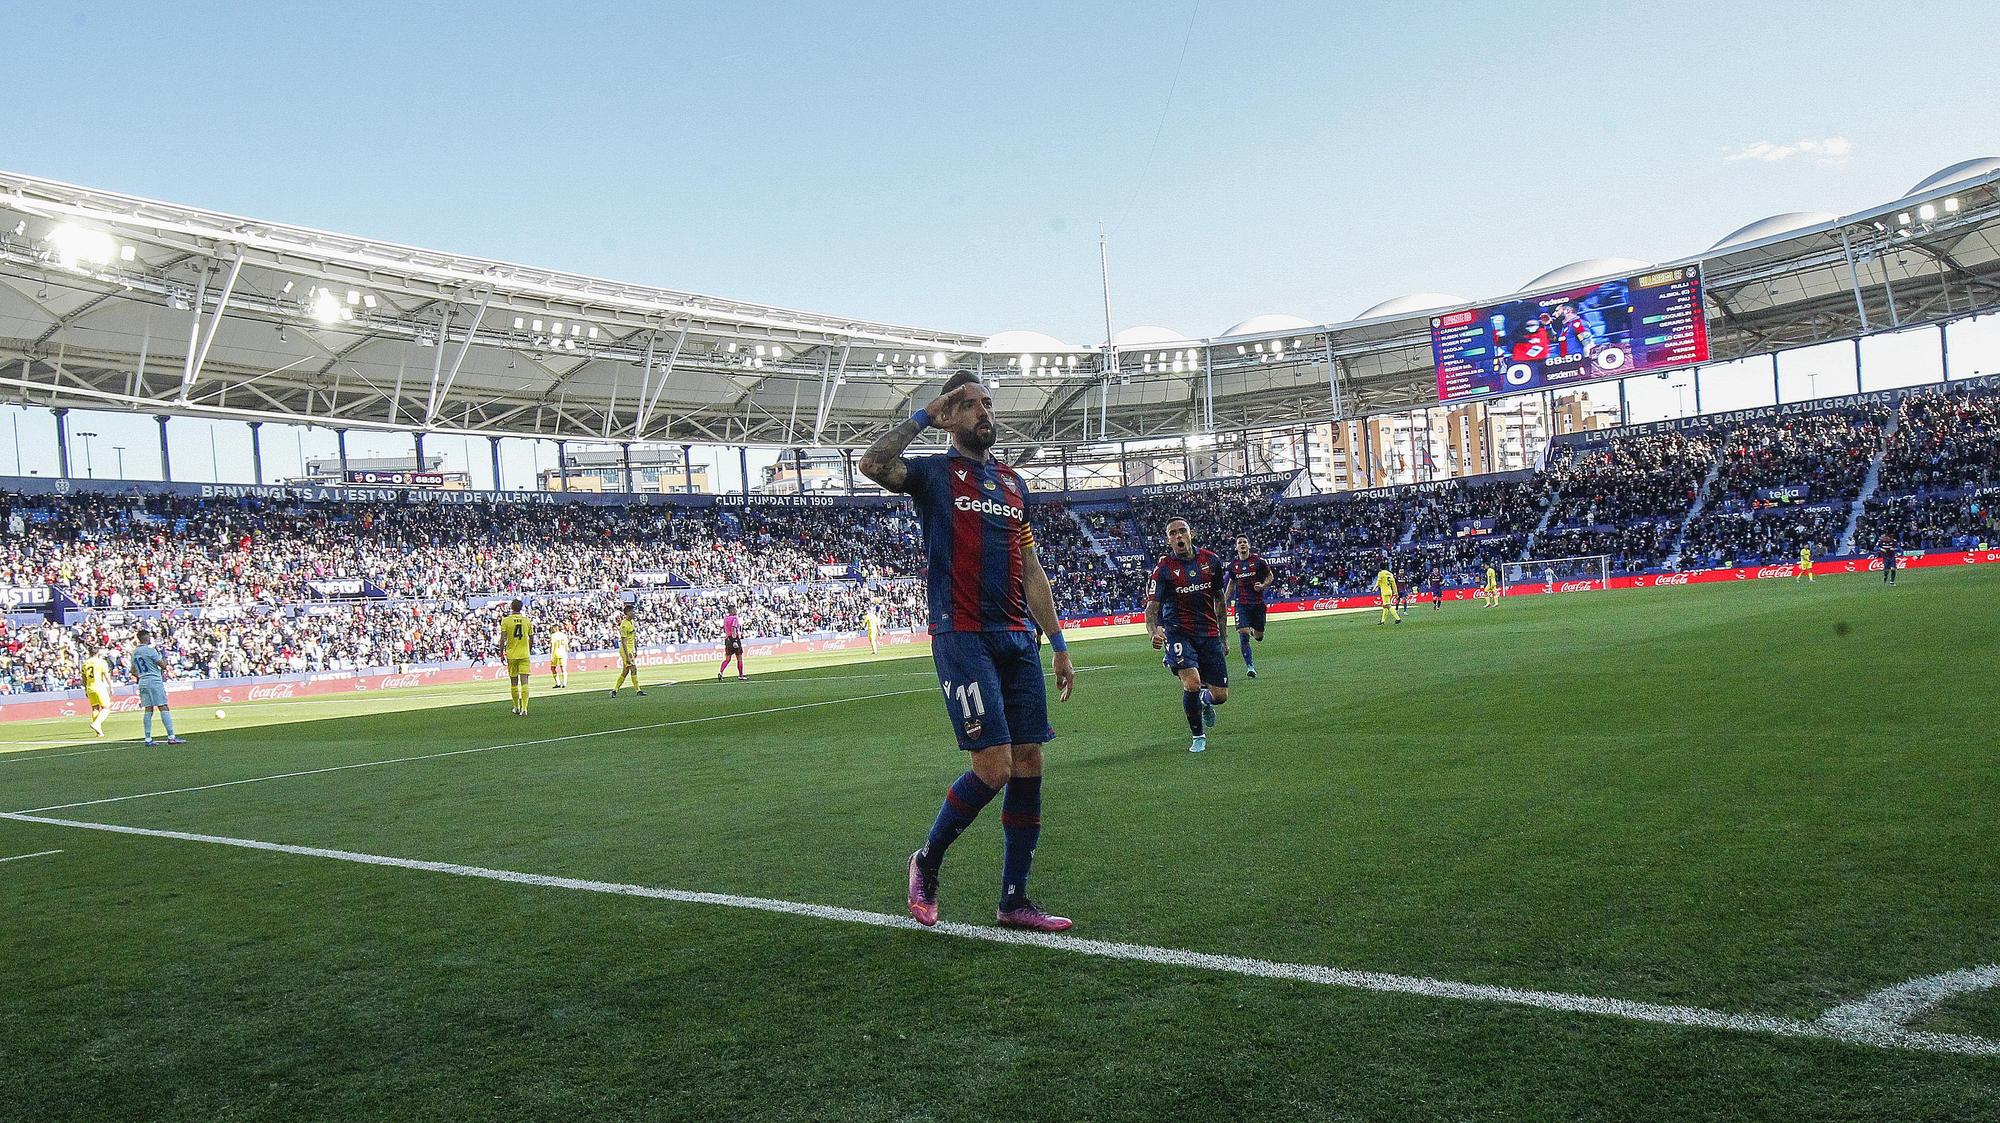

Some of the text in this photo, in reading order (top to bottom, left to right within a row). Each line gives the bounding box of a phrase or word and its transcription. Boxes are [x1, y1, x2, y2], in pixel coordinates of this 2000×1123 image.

[1546, 353, 1582, 366] 68:50
[1657, 421, 1676, 432] EN
[1682, 416, 1709, 429] LAS
[1781, 391, 1892, 415] AZULGRANAS
[1897, 386, 1920, 398] DE
[415, 476, 441, 484] 68:50
[1223, 479, 1243, 488] SER
[318, 488, 330, 500] A
[464, 493, 482, 503] DE
[715, 496, 834, 506] CLUB FUNDAT EN 1909
[954, 495, 1024, 521] Gedesco
[1655, 573, 1688, 586] Coca-Cola
[1757, 566, 1794, 579] Coca-Cola
[1561, 581, 1592, 592] Coca-Cola
[1313, 599, 1339, 610] Coca-Cola
[513, 623, 523, 640] 4
[1173, 642, 1183, 657] 9
[381, 674, 421, 690] Coca-Cola
[249, 683, 295, 700] Coca-Cola
[956, 681, 985, 719] 11
